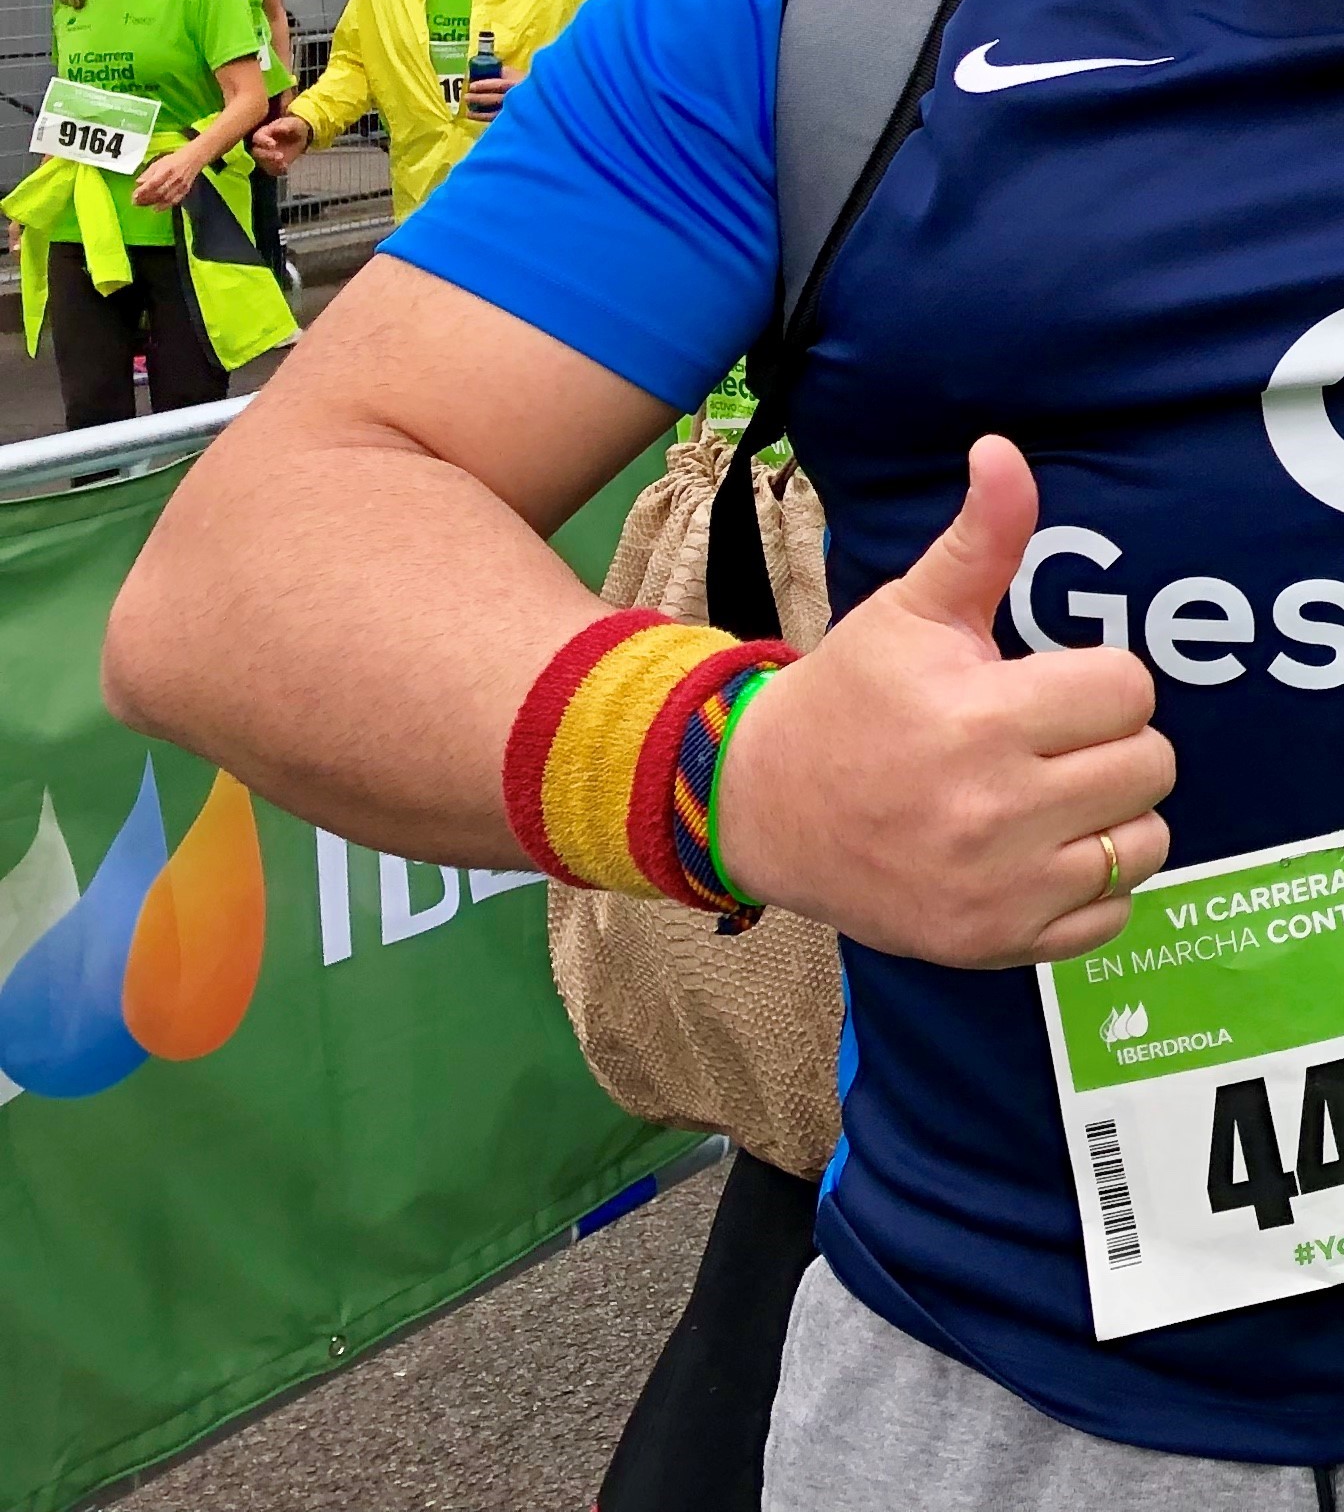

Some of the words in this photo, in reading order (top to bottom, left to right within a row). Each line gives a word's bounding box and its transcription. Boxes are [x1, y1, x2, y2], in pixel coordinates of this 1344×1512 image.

[58, 120, 124, 159] 9164
[1165, 902, 1199, 934] VI
[1084, 956, 1126, 985] EN
[1131, 925, 1262, 974] MARCHA
[1115, 1027, 1233, 1066] IBERDROLA
